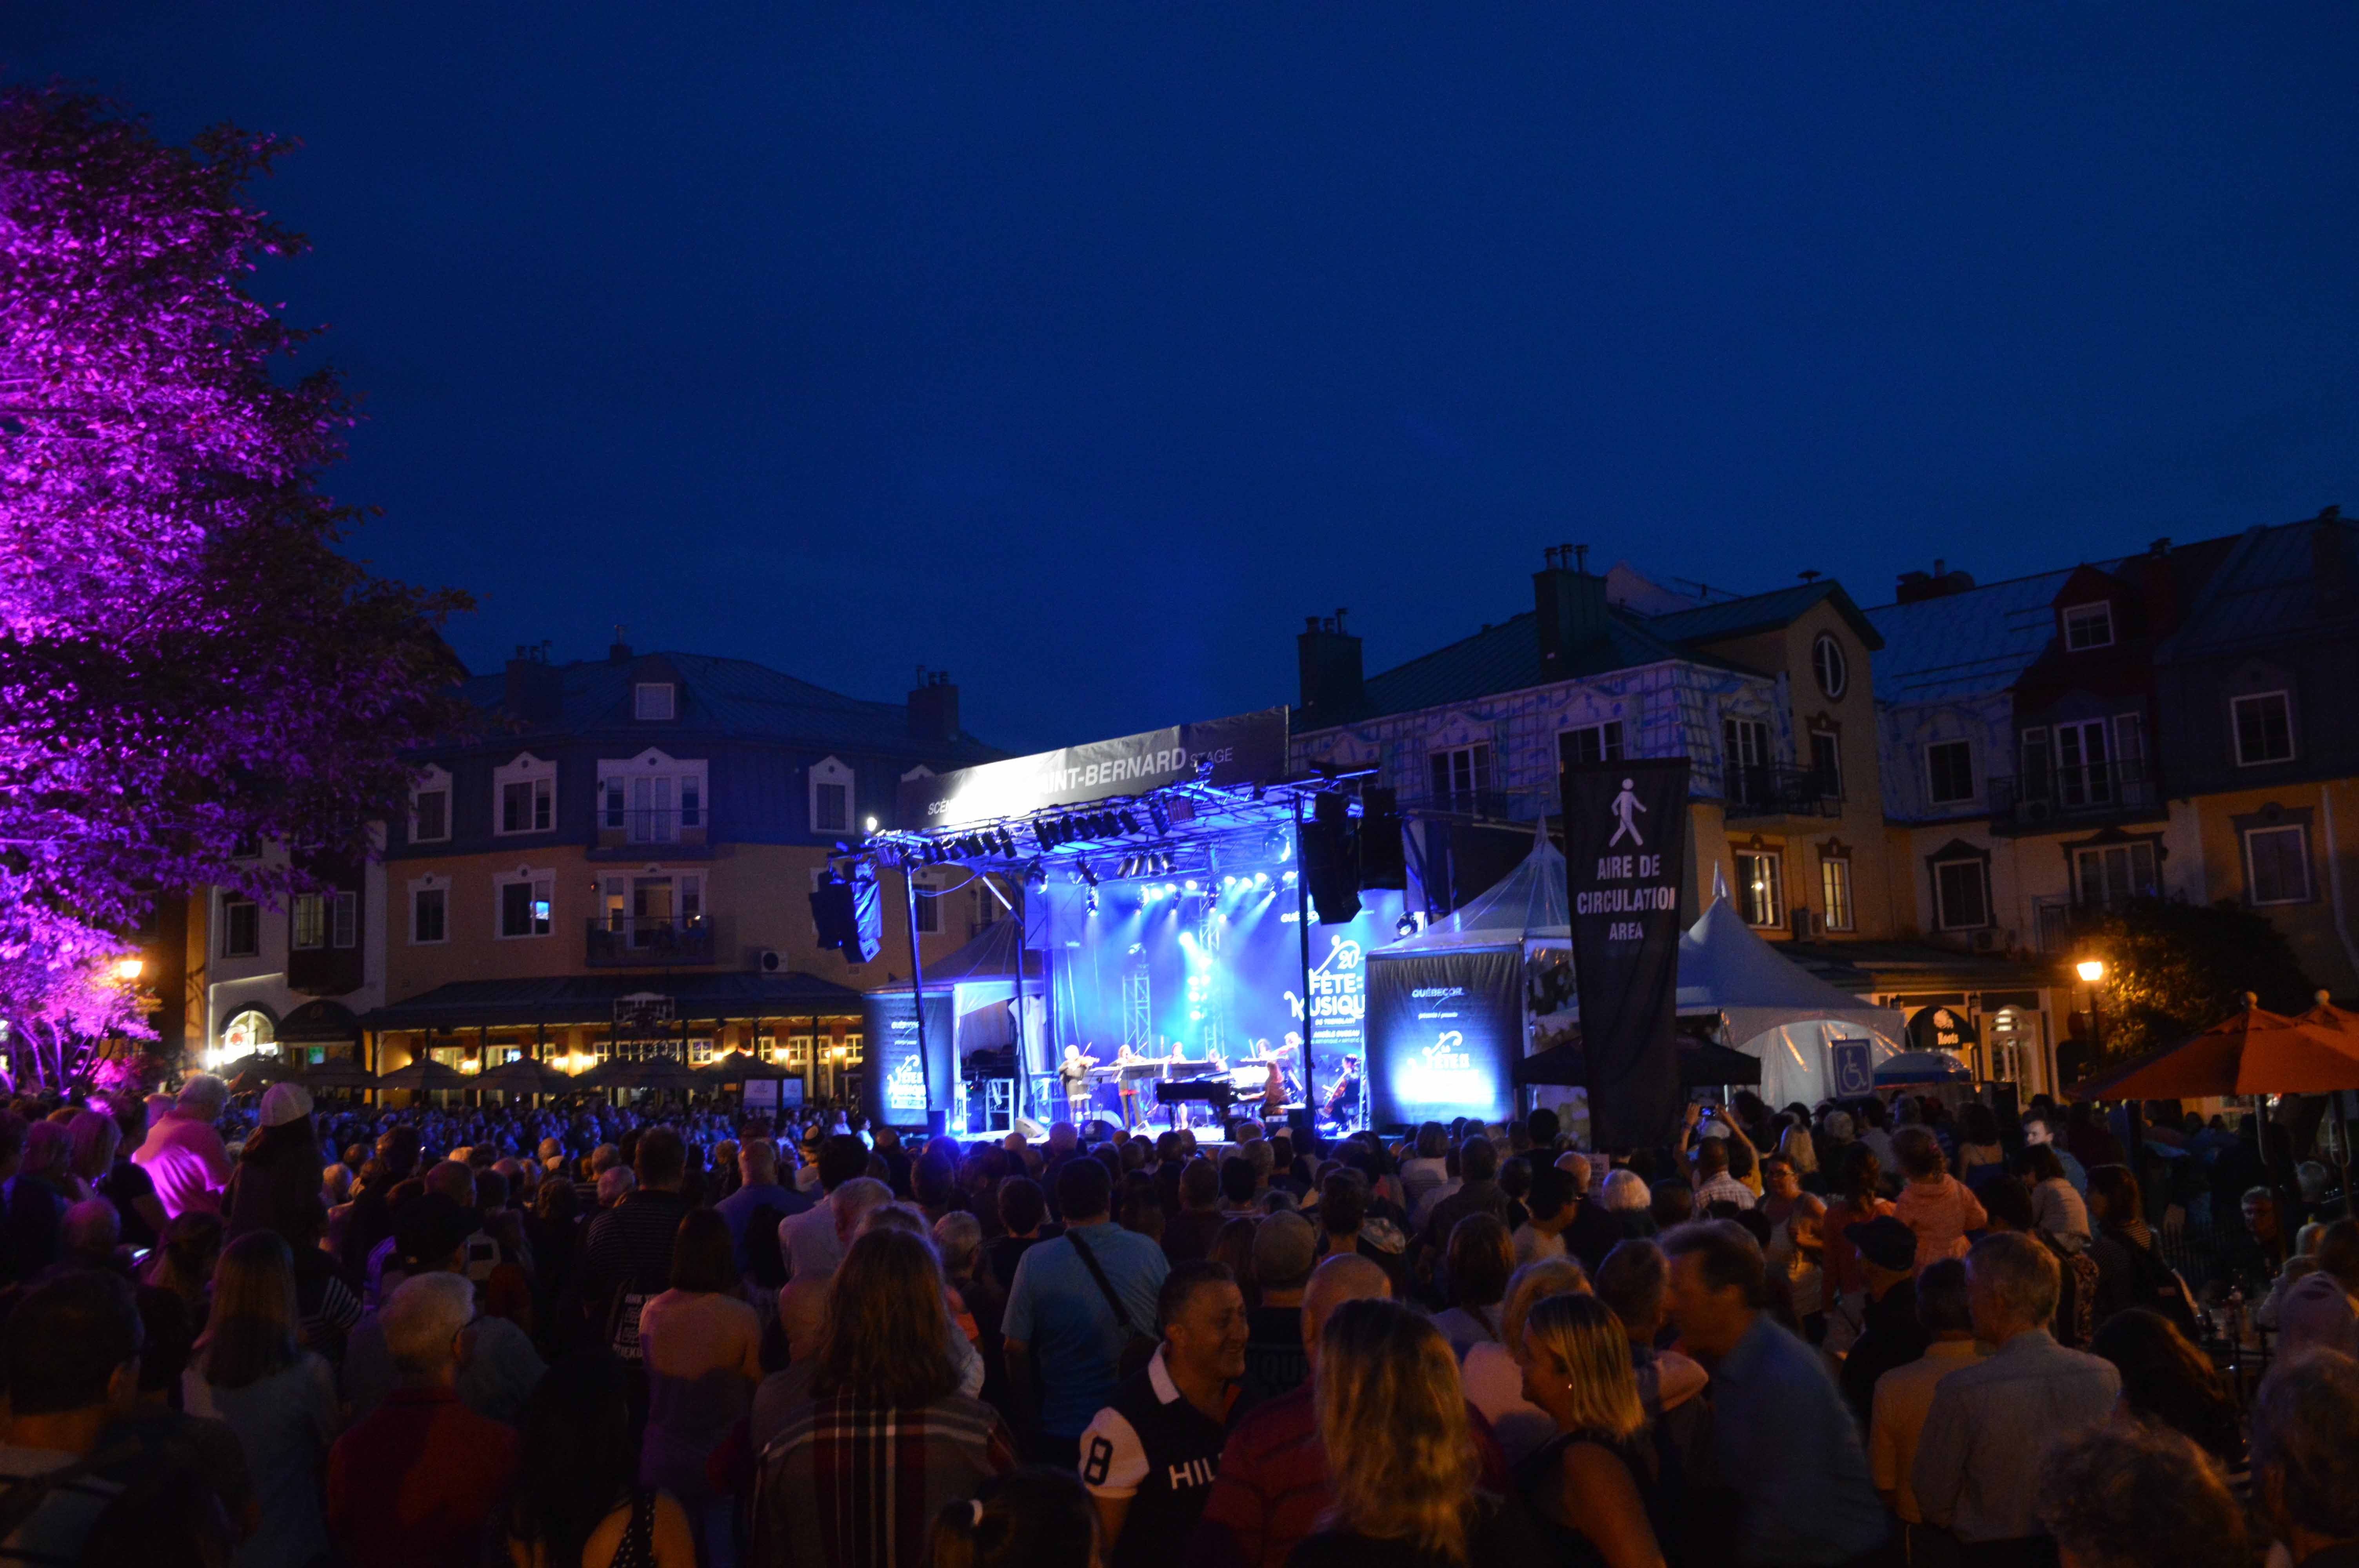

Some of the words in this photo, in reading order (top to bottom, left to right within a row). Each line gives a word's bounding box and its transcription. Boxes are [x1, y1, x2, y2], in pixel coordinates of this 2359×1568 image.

[1597, 855, 1632, 880] AIRE
[1640, 854, 1660, 878] DE
[1609, 922, 1644, 940] AREA
[1283, 991, 1365, 1022] MUSIQU
[1169, 1456, 1217, 1490] HIL
